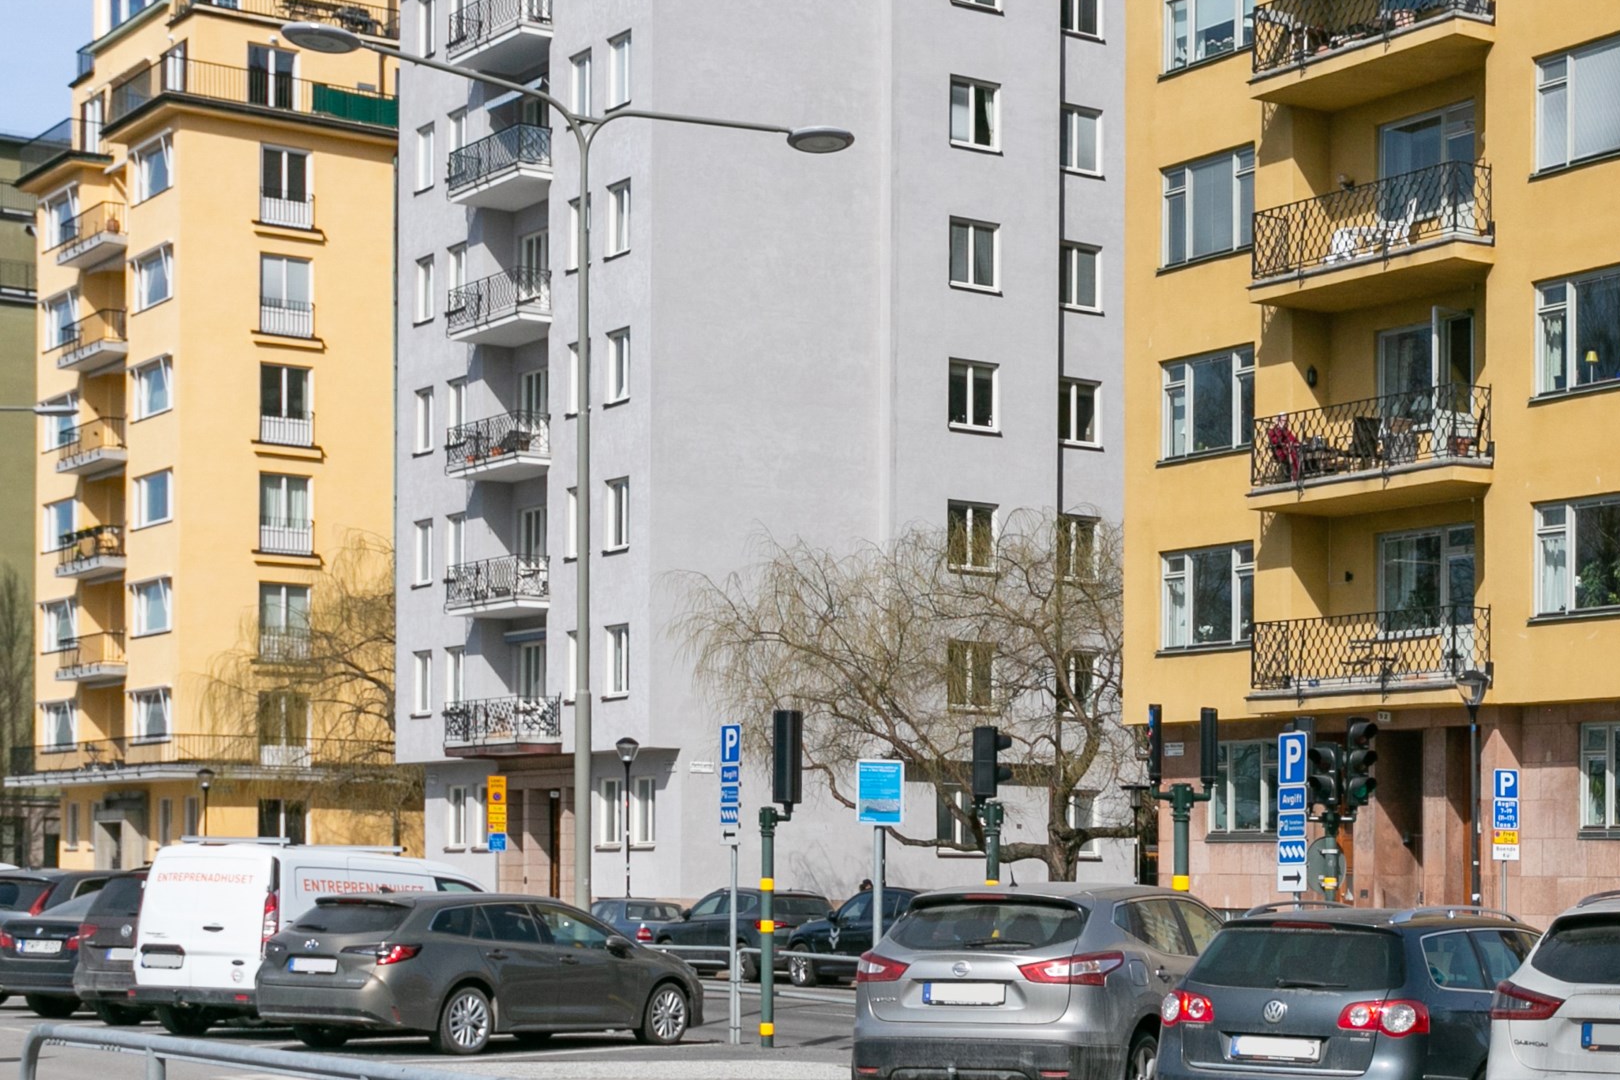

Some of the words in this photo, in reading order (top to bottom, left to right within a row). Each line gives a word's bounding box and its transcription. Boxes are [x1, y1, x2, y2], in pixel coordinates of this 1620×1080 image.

[725, 728, 738, 760] P
[1286, 738, 1302, 780] P
[1500, 772, 1515, 796] P
[1282, 793, 1303, 806] Avgift
[1497, 801, 1516, 809] Avgift
[157, 872, 253, 884] ENTREPRENADHUSET
[303, 878, 424, 893] ENTREPRENAHUS
